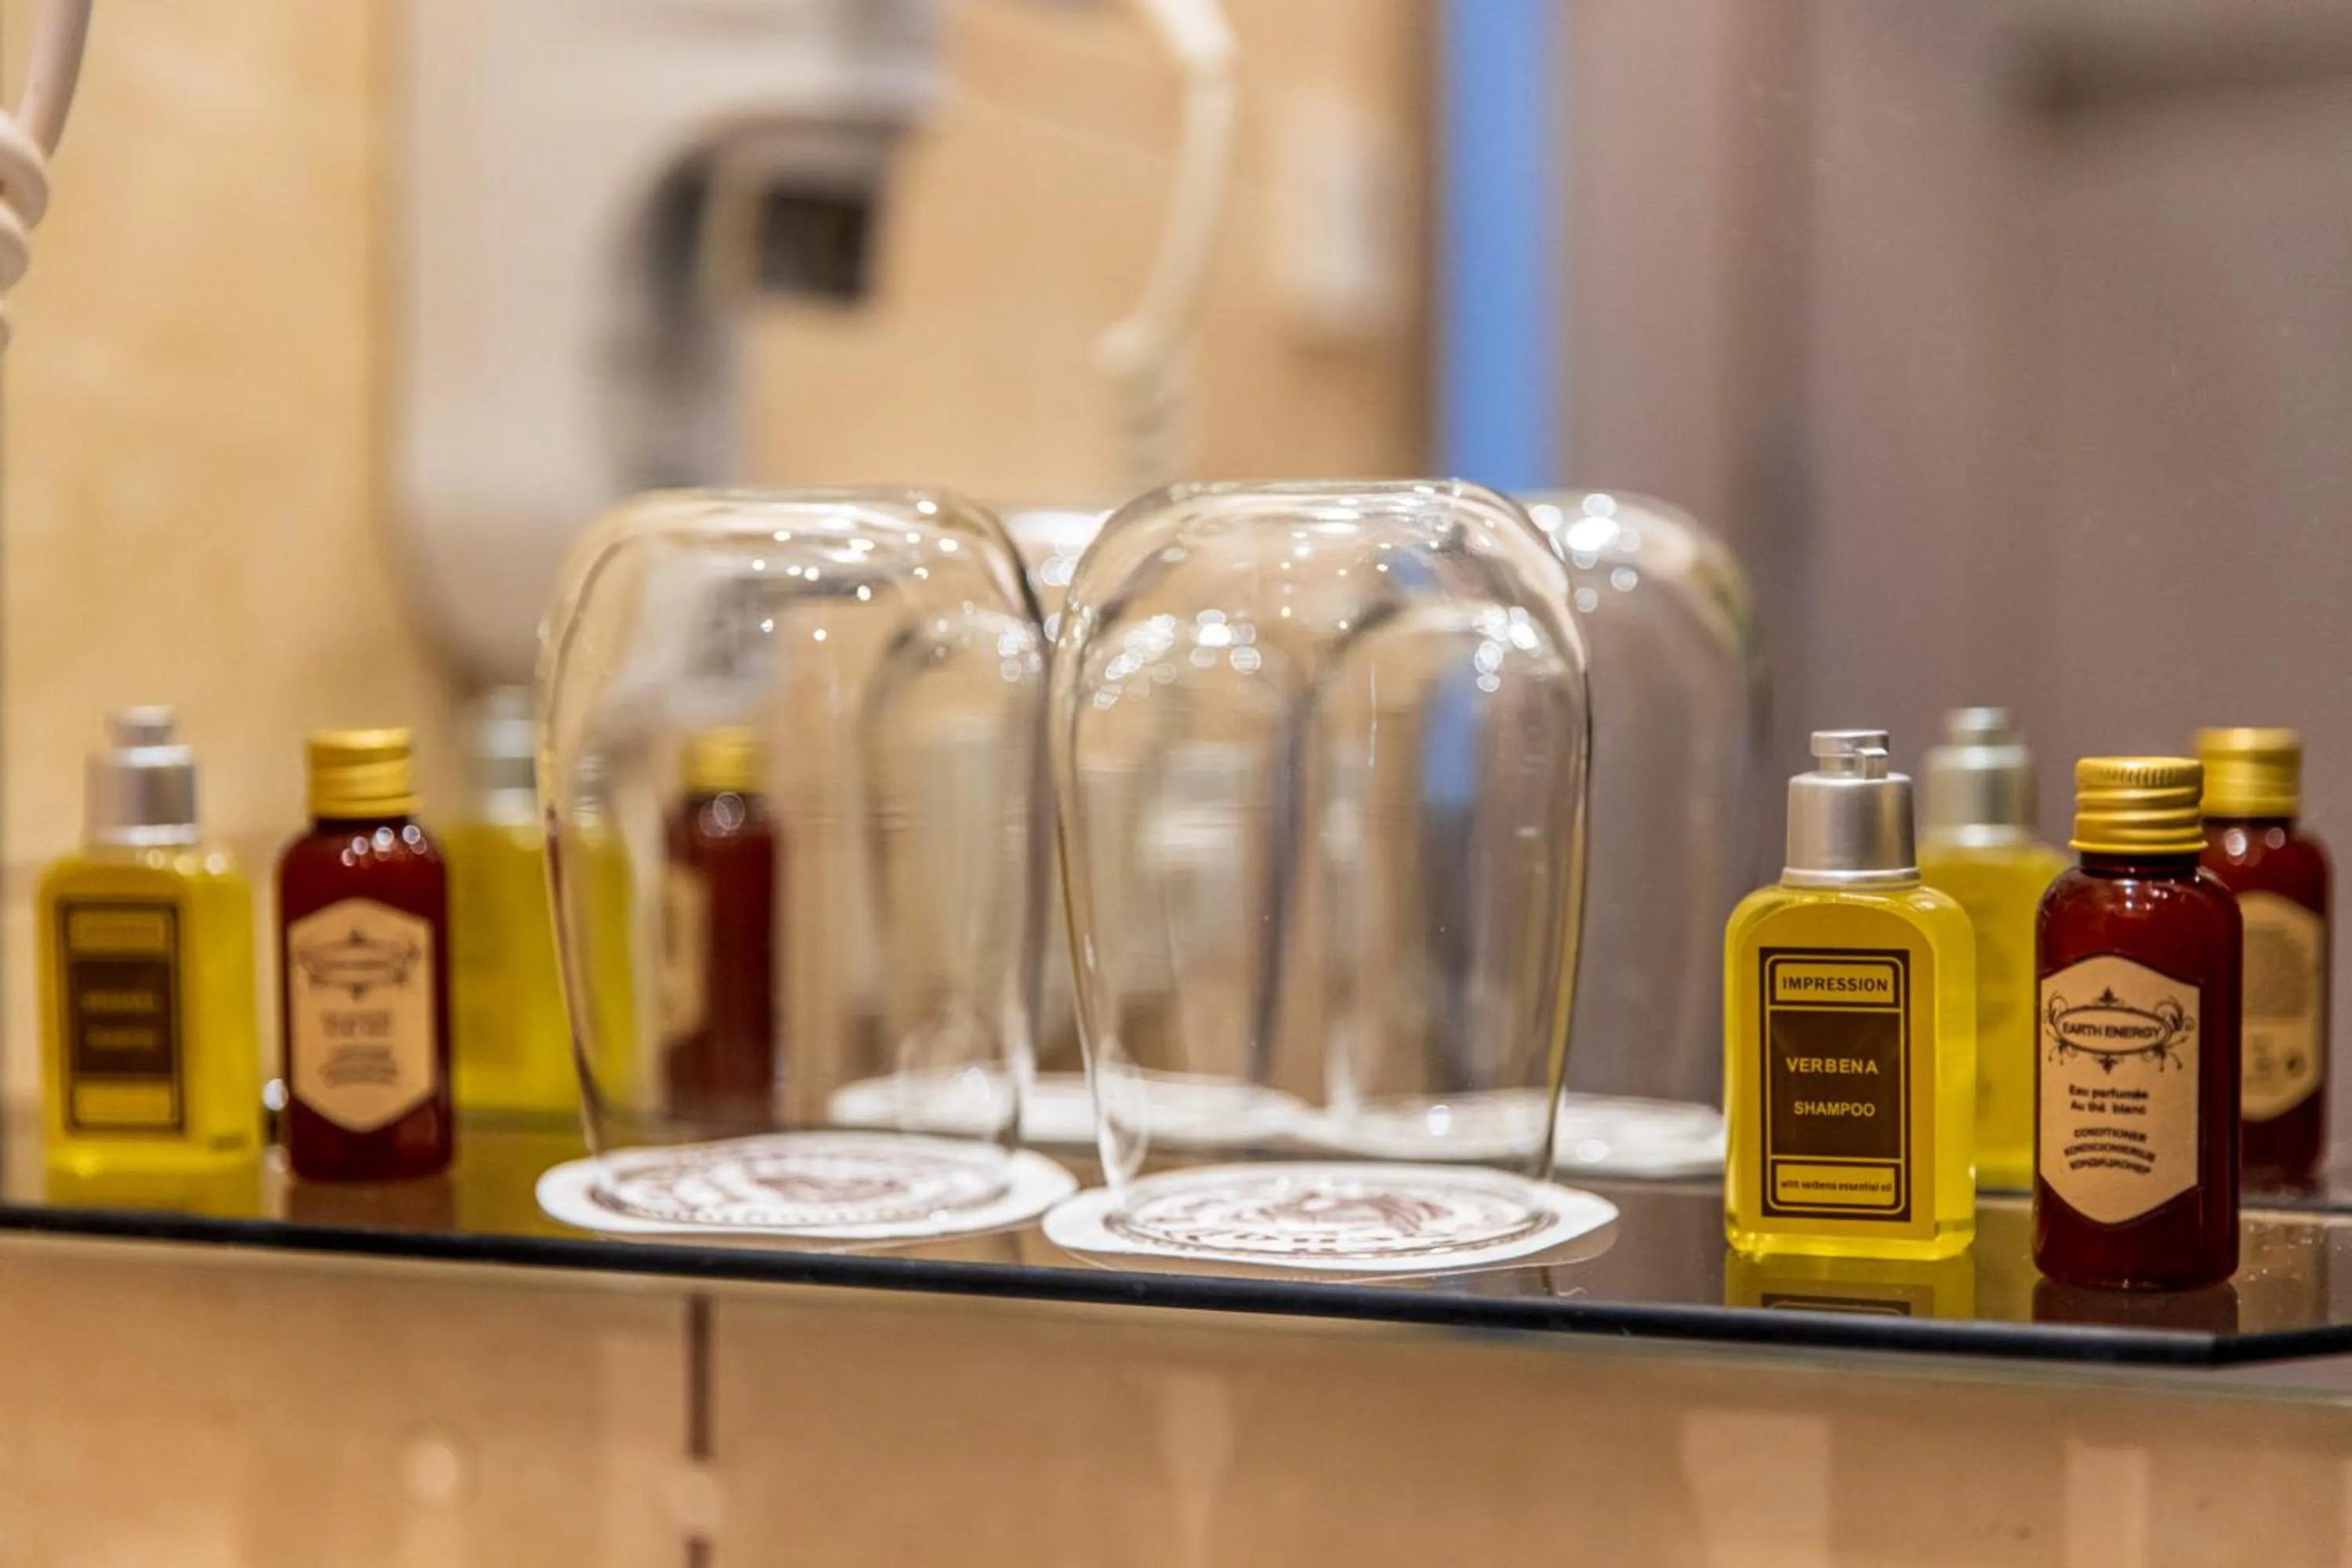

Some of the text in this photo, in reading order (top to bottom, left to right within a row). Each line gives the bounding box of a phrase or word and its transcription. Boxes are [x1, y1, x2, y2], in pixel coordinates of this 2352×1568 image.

[1782, 976, 1888, 992] IMPRESSION
[2063, 1022, 2162, 1040] EARTH ENERGY
[1786, 1057, 1879, 1075] VERBENA
[1794, 1101, 1875, 1117] SHAMPOO
